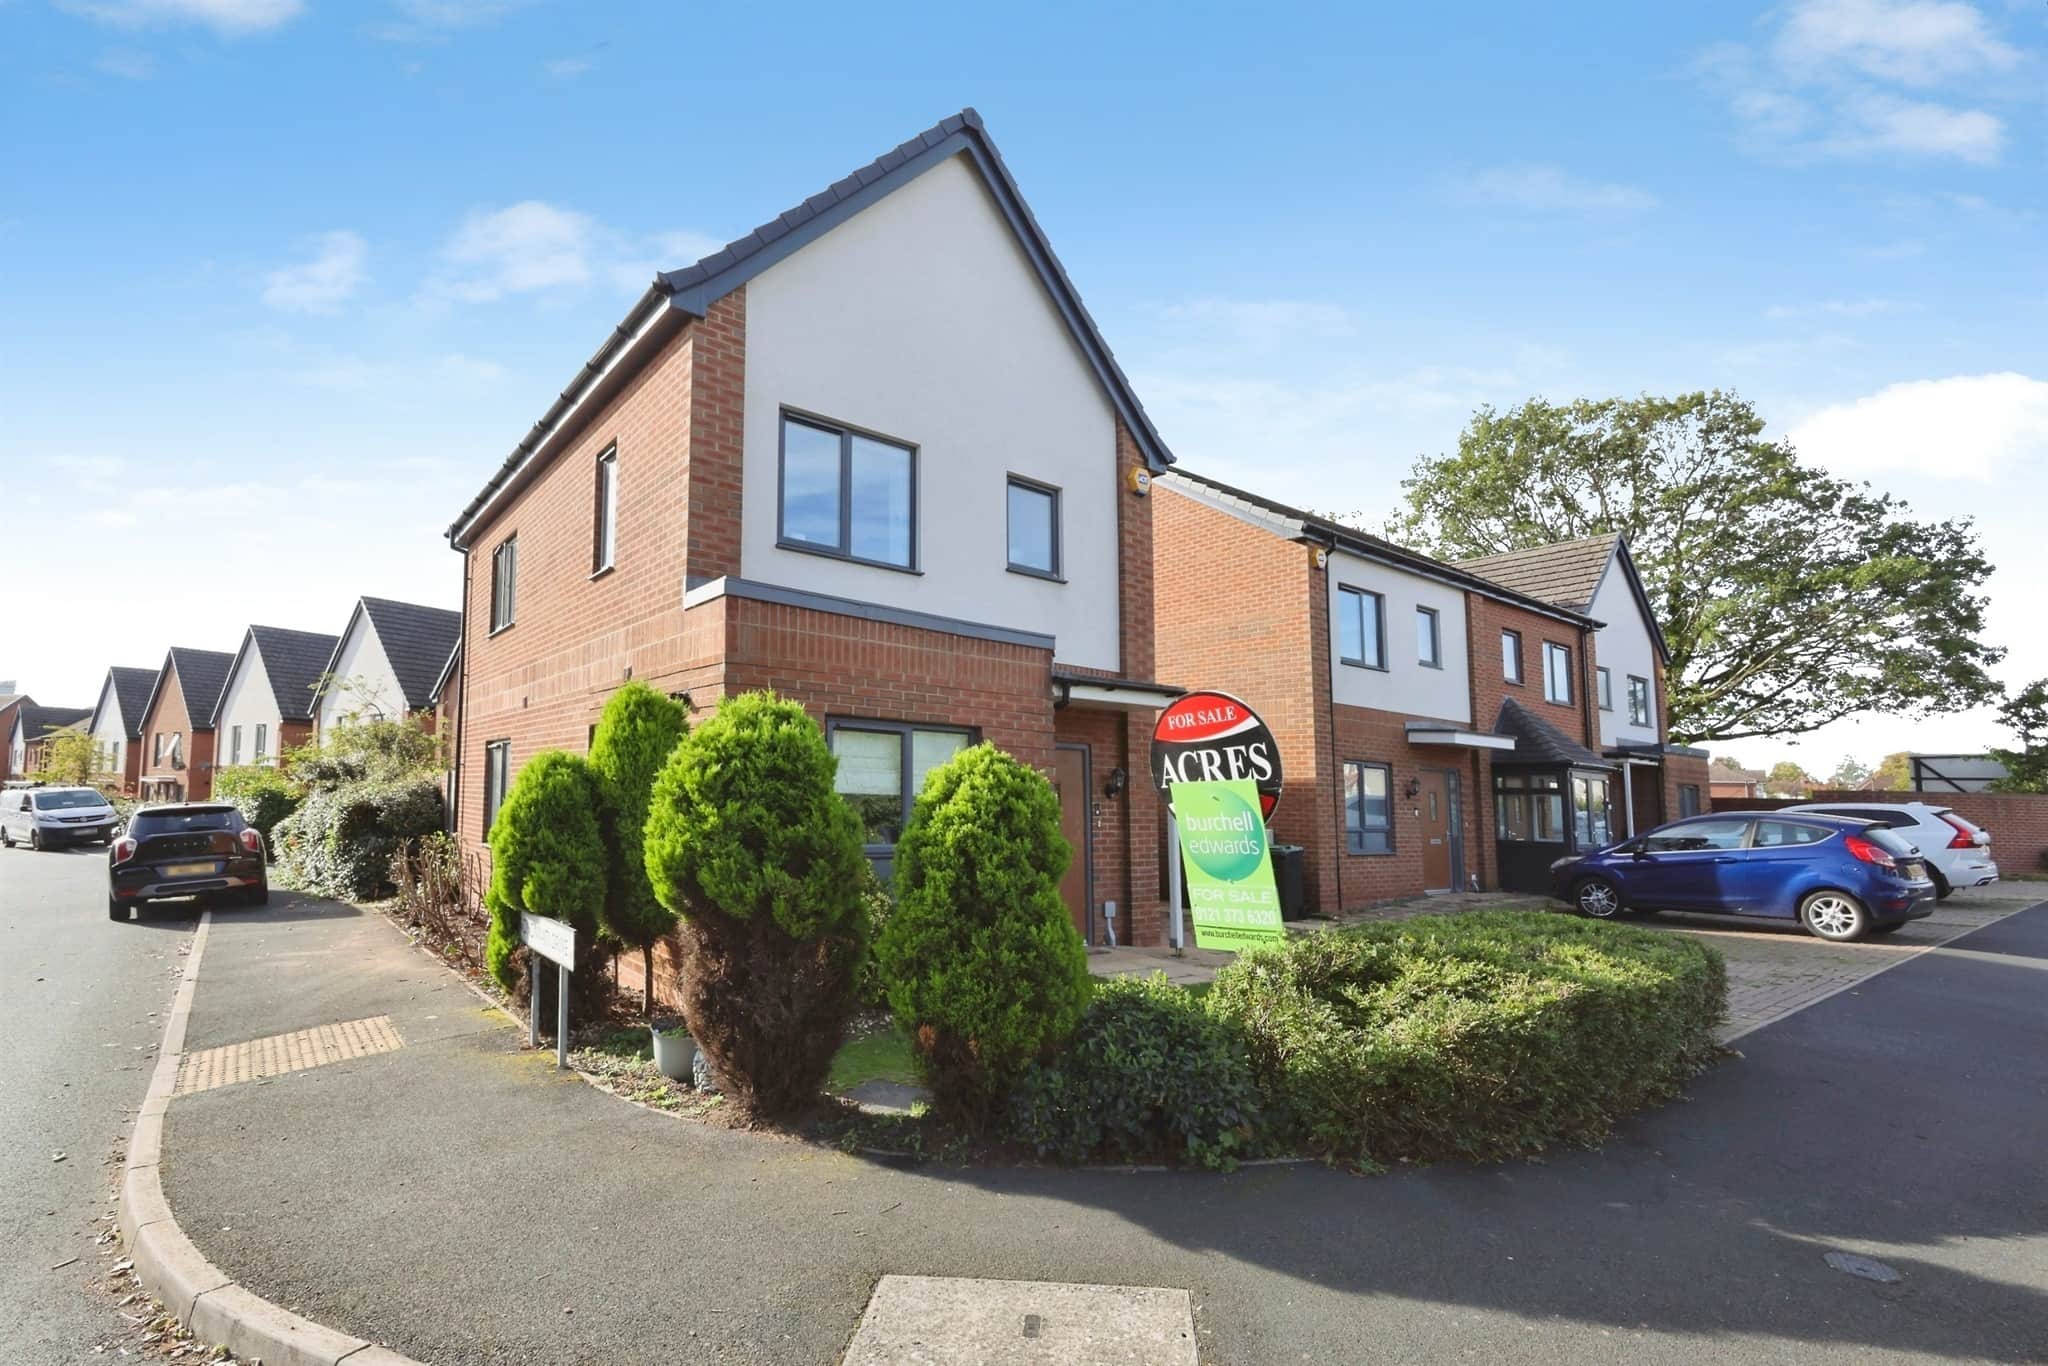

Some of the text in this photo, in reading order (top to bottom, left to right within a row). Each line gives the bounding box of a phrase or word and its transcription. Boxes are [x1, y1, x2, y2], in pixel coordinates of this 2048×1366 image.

[1167, 705, 1238, 731] FOR SALE
[1161, 742, 1272, 789] ACRES
[1185, 810, 1254, 833] burchell
[1189, 836, 1260, 856] edwards
[1192, 887, 1273, 904] FOR SALE
[1195, 906, 1220, 921] 0121
